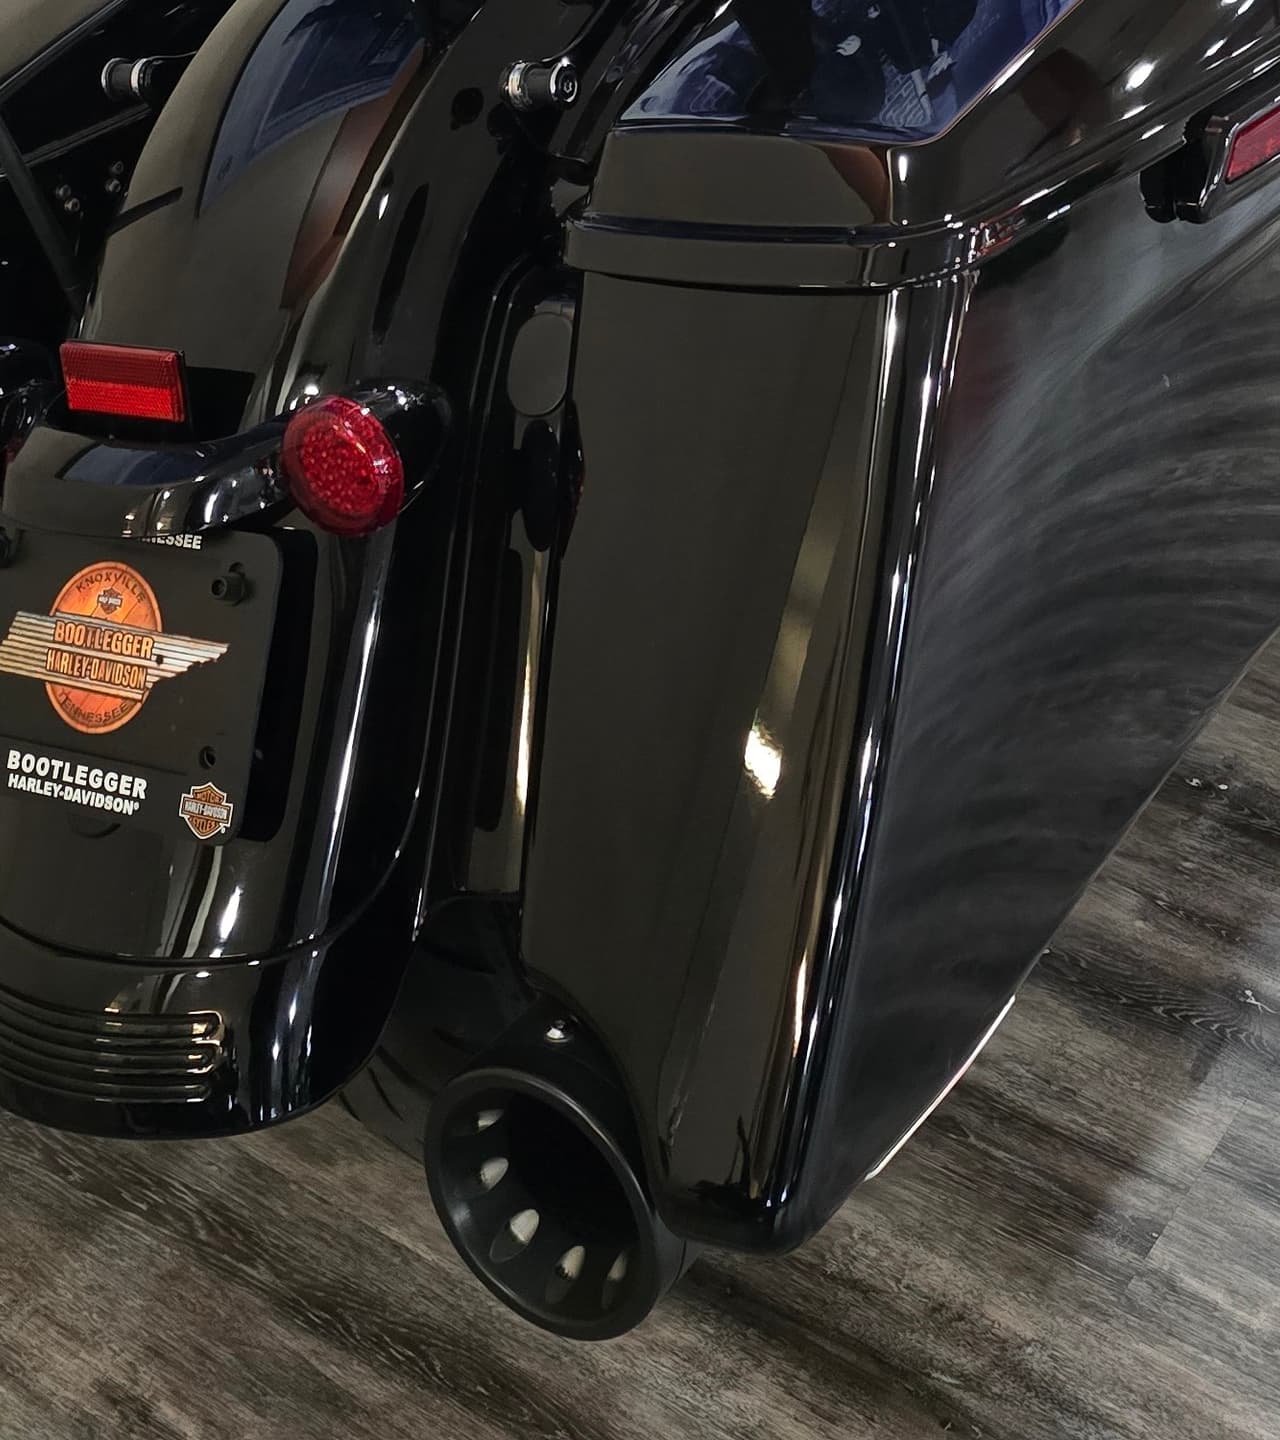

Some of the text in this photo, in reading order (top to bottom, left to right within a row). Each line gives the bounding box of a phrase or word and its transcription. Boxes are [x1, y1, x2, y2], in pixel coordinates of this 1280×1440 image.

[75, 571, 147, 604] KNOXVILLE
[54, 621, 154, 659] BOOTLEGGER
[58, 688, 130, 724] TENNESSEE
[6, 749, 148, 800] BOOTLEGGER
